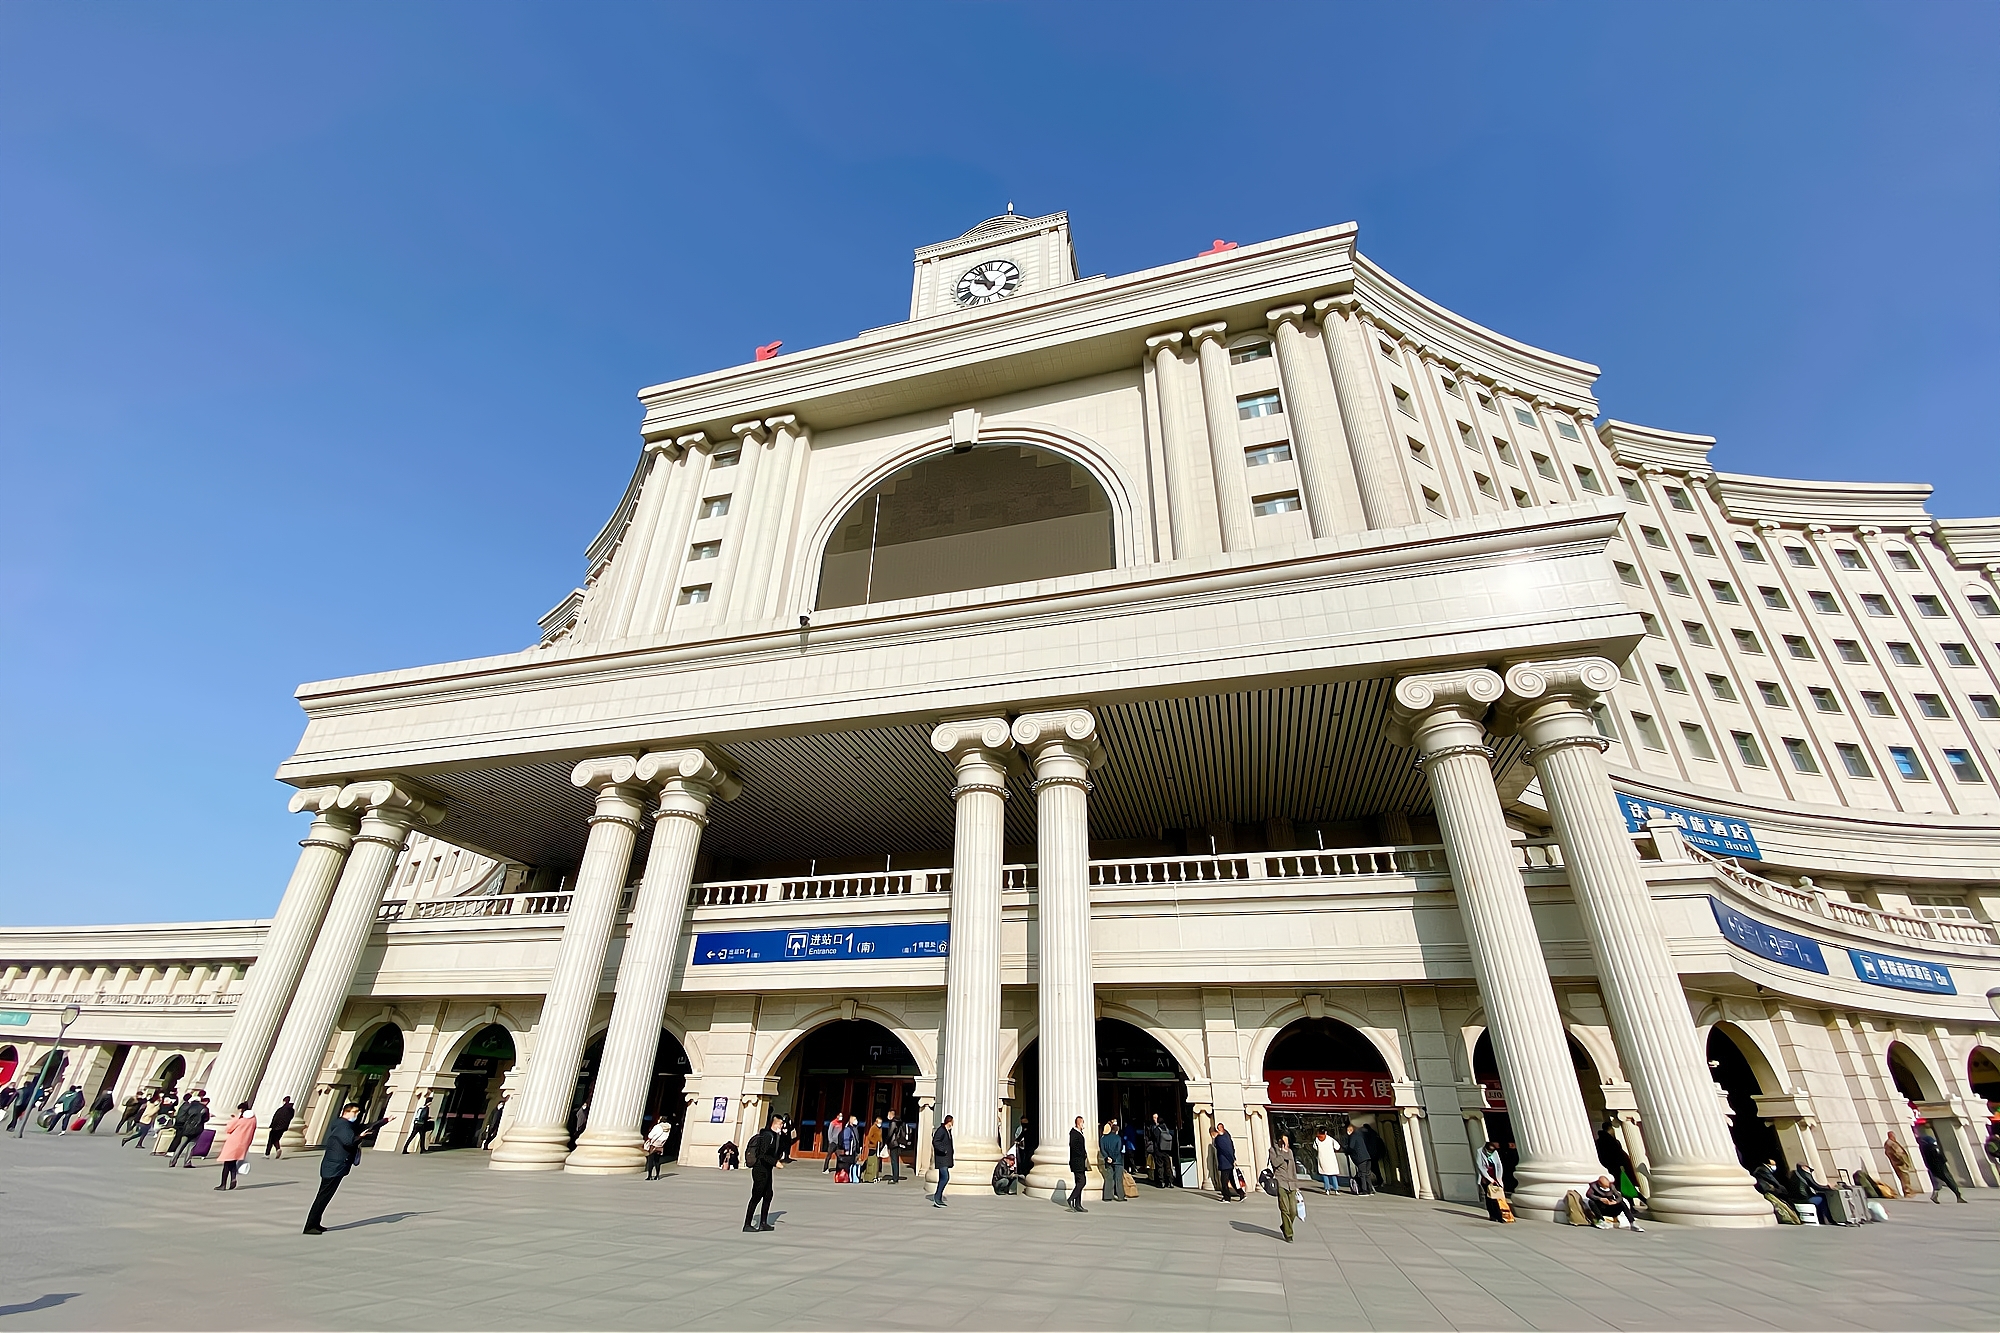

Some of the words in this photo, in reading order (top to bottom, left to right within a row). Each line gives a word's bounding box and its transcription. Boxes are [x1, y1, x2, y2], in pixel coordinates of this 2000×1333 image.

[1626, 801, 1750, 840] 铁商旅酒店
[1723, 839, 1754, 853] Hotel
[810, 934, 843, 946] 进站口
